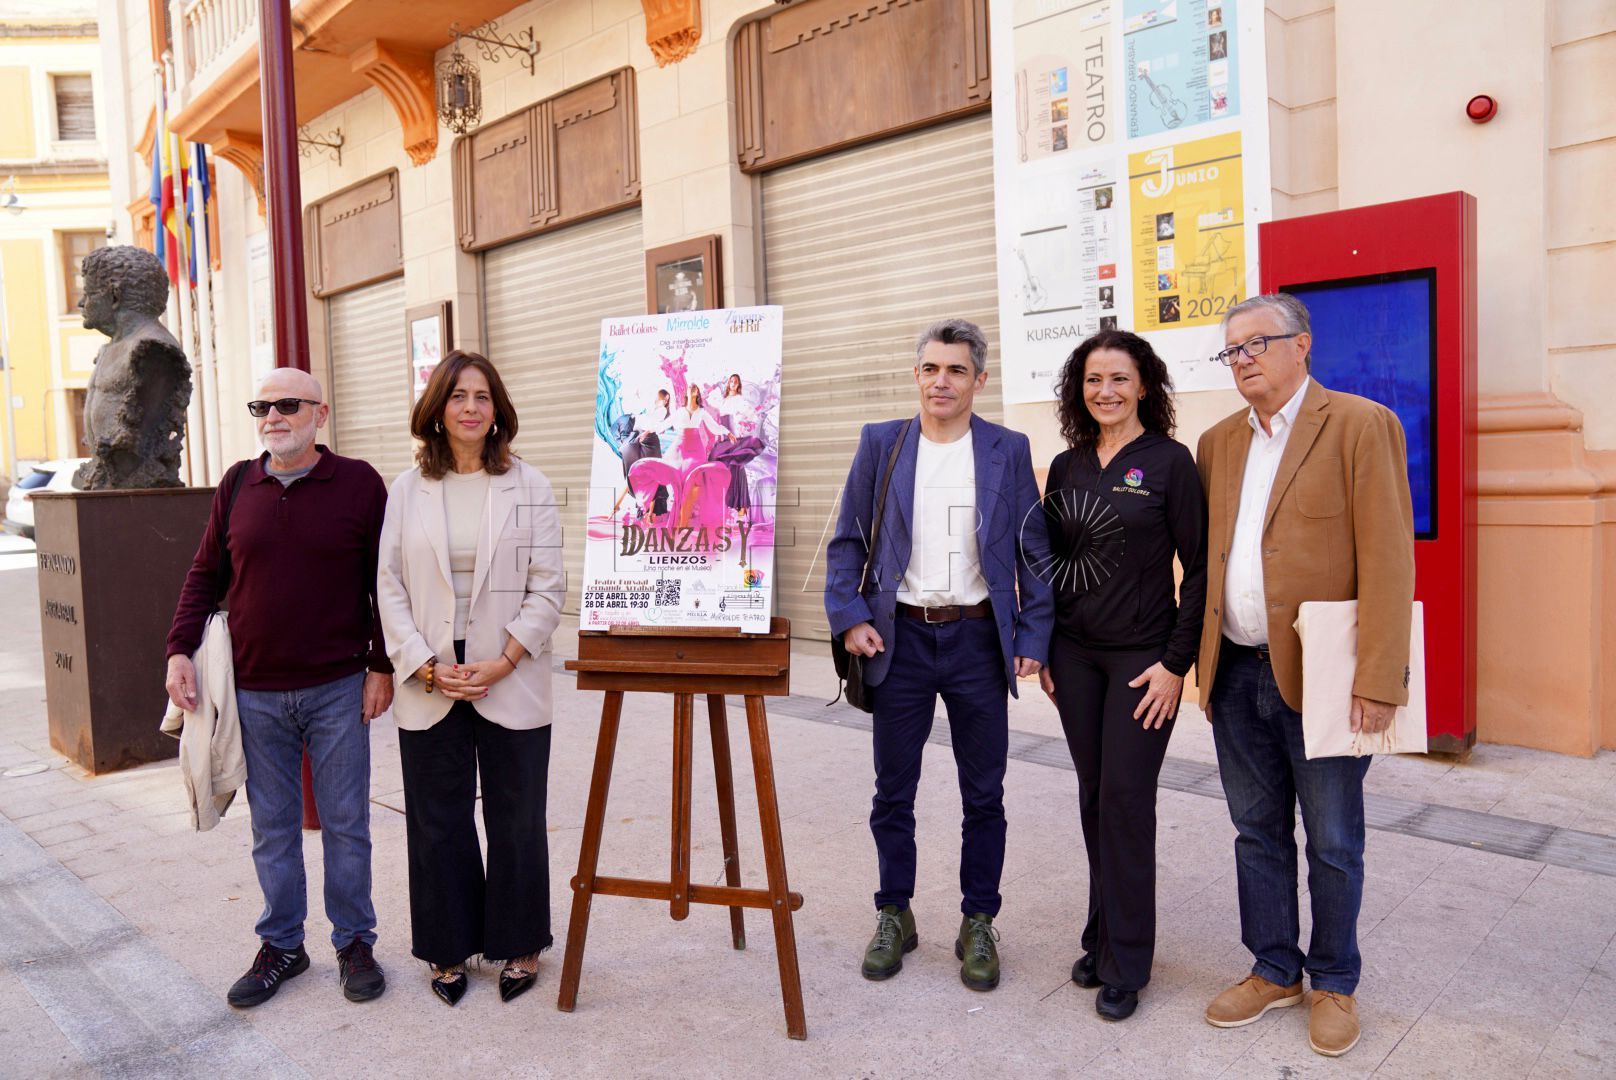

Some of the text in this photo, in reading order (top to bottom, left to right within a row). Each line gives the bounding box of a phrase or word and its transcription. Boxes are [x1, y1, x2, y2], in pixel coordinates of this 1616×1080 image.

[1127, 38, 1137, 82] ARRABAL
[1084, 36, 1106, 142] TEATRO
[1128, 84, 1139, 138] FERNANDO
[1187, 294, 1238, 318] 2024
[609, 324, 630, 336] Ballet
[1027, 324, 1084, 341] KURSAAL
[650, 556, 707, 565] LIENZOS
[630, 592, 650, 600] 20:30
